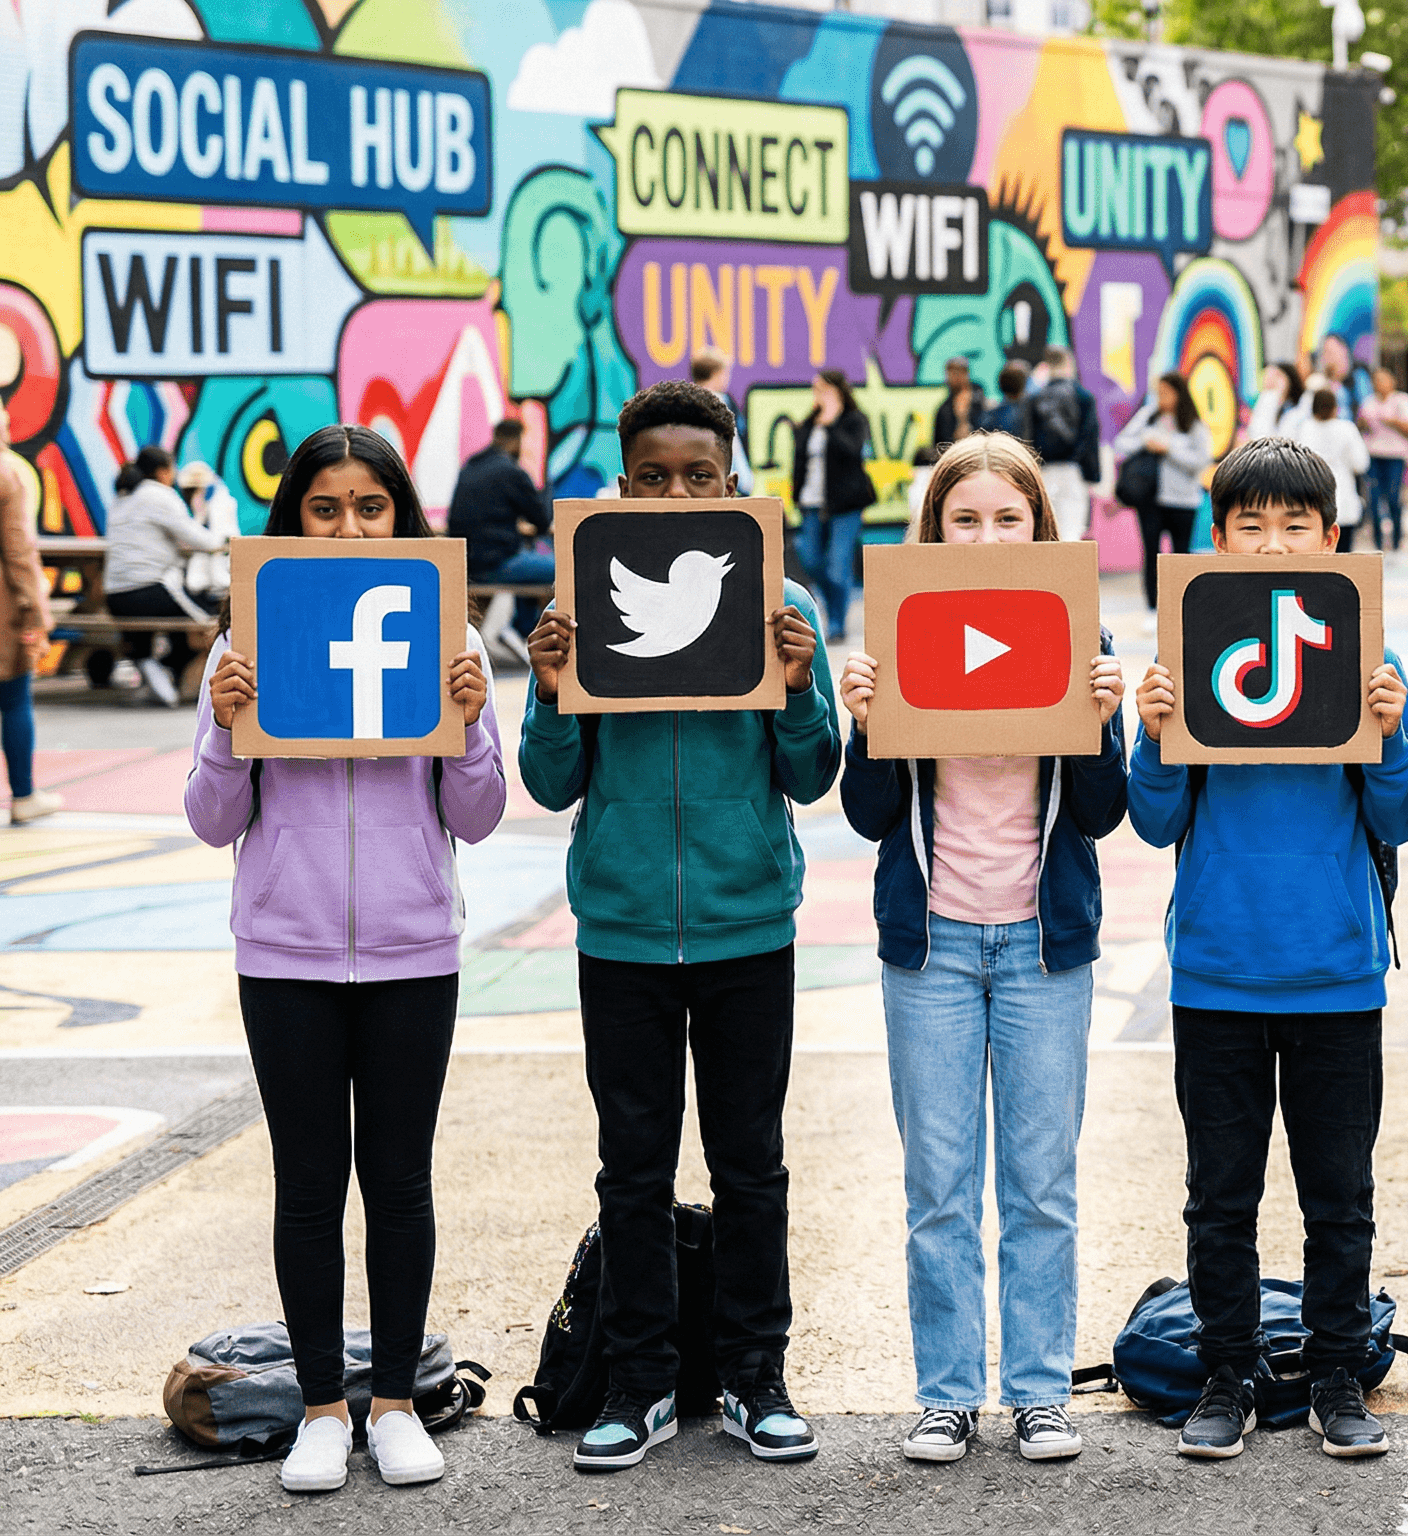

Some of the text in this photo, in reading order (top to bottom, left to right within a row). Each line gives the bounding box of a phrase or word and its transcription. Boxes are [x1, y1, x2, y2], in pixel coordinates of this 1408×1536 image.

[87, 63, 476, 193] SOCIAL HUB
[630, 123, 835, 219] CONNECT
[859, 193, 979, 281] WIFI
[1063, 138, 1208, 241] UNITY
[98, 252, 283, 355] WIFI
[642, 262, 840, 368] UNITY
